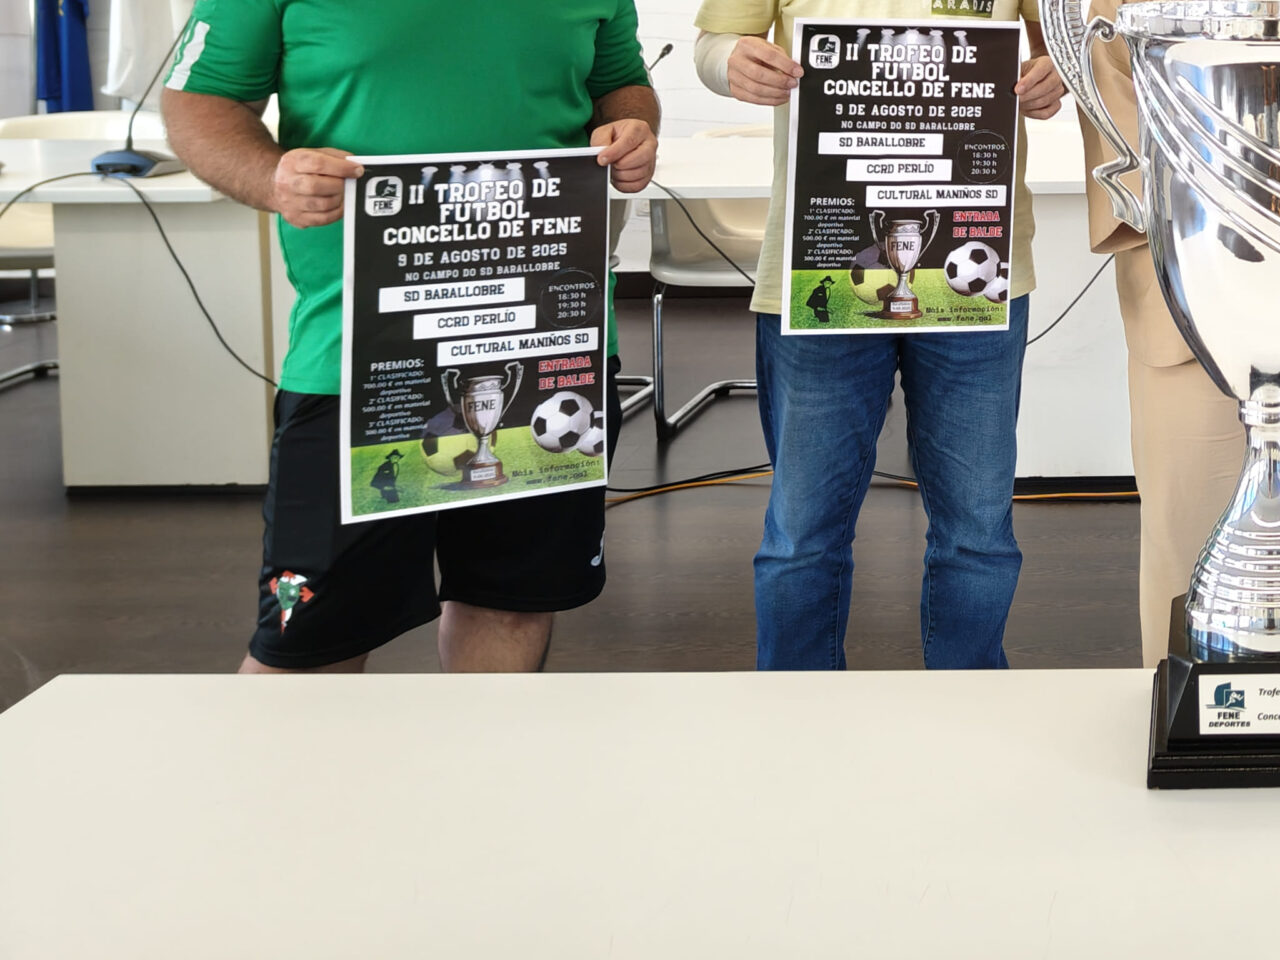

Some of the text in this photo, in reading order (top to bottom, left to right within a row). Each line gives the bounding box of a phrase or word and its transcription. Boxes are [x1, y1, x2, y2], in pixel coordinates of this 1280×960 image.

[816, 55, 832, 64] FENE
[846, 44, 976, 63] II TROFEO DE
[872, 63, 949, 81] FUTBOL
[824, 80, 995, 98] CONCELLO DE FENE
[835, 104, 982, 117] 9 DE AGOSTO DE 2025
[841, 121, 853, 129] NO
[856, 121, 886, 129] CAMPO
[905, 122, 916, 130] SD
[919, 122, 975, 131] BARALLOBRE
[839, 137, 925, 147] SD BARALLOBRE
[866, 161, 934, 174] CCRD PERLÍO
[408, 178, 561, 204] II TROFEO DE
[878, 187, 998, 200] CULTURAL MANIÑOS SD
[373, 199, 393, 210] FENE
[810, 198, 855, 206] PREMIOS:
[440, 200, 530, 223] FUTBOL
[953, 211, 999, 222] ENTRADA
[383, 217, 581, 245] CONCELLO DE FENE
[953, 226, 1002, 237] DE BALDE
[891, 241, 915, 251] FENE
[398, 243, 567, 266] 9 DE AGOSTO DE 2025
[405, 261, 560, 281] NO CAMPO DO SD BARALLOBRE
[404, 284, 504, 302] SD BARALLOBRE
[549, 282, 595, 292] ENCONTROS
[558, 292, 579, 300] 18:30
[558, 301, 579, 309] 19:30
[437, 310, 515, 328] CCRD PERLÍO
[557, 311, 579, 319] 20:30
[451, 333, 589, 357] CULTURAL MANIÑOS SD
[371, 359, 424, 372] PREMIOS:
[538, 356, 591, 372] ENTRADA
[538, 373, 595, 389] DE BALDE
[467, 399, 496, 412] FENE
[1218, 712, 1240, 720] FENE
